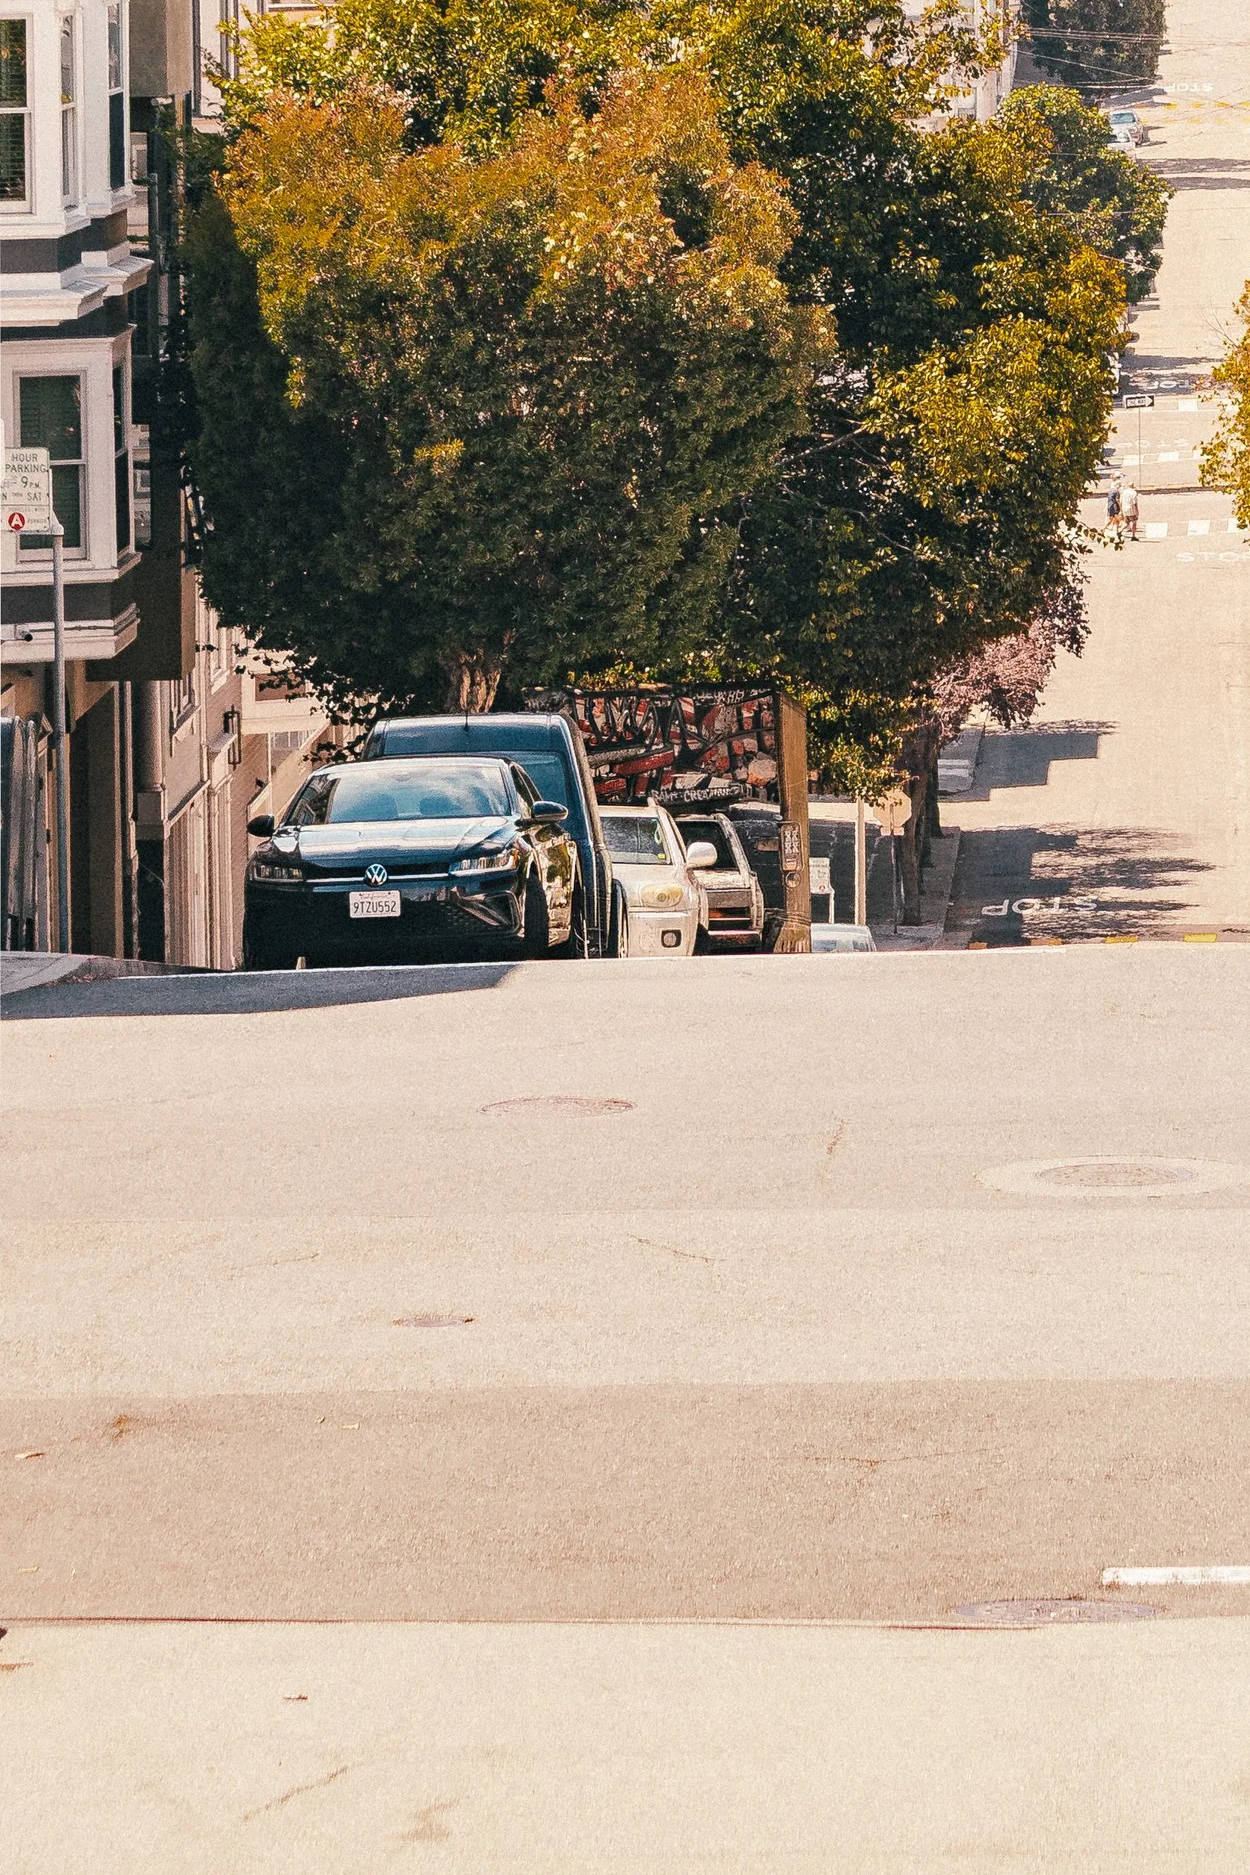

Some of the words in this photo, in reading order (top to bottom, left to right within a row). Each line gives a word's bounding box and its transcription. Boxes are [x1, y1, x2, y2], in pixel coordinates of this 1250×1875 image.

[1166, 82, 1214, 93] STOP
[12, 453, 38, 463] HOUR
[5, 464, 46, 473] PARKING
[27, 492, 42, 501] SAT
[10, 513, 24, 527] A
[353, 900, 397, 914] 9TZU552
[981, 895, 1098, 916] STOP
